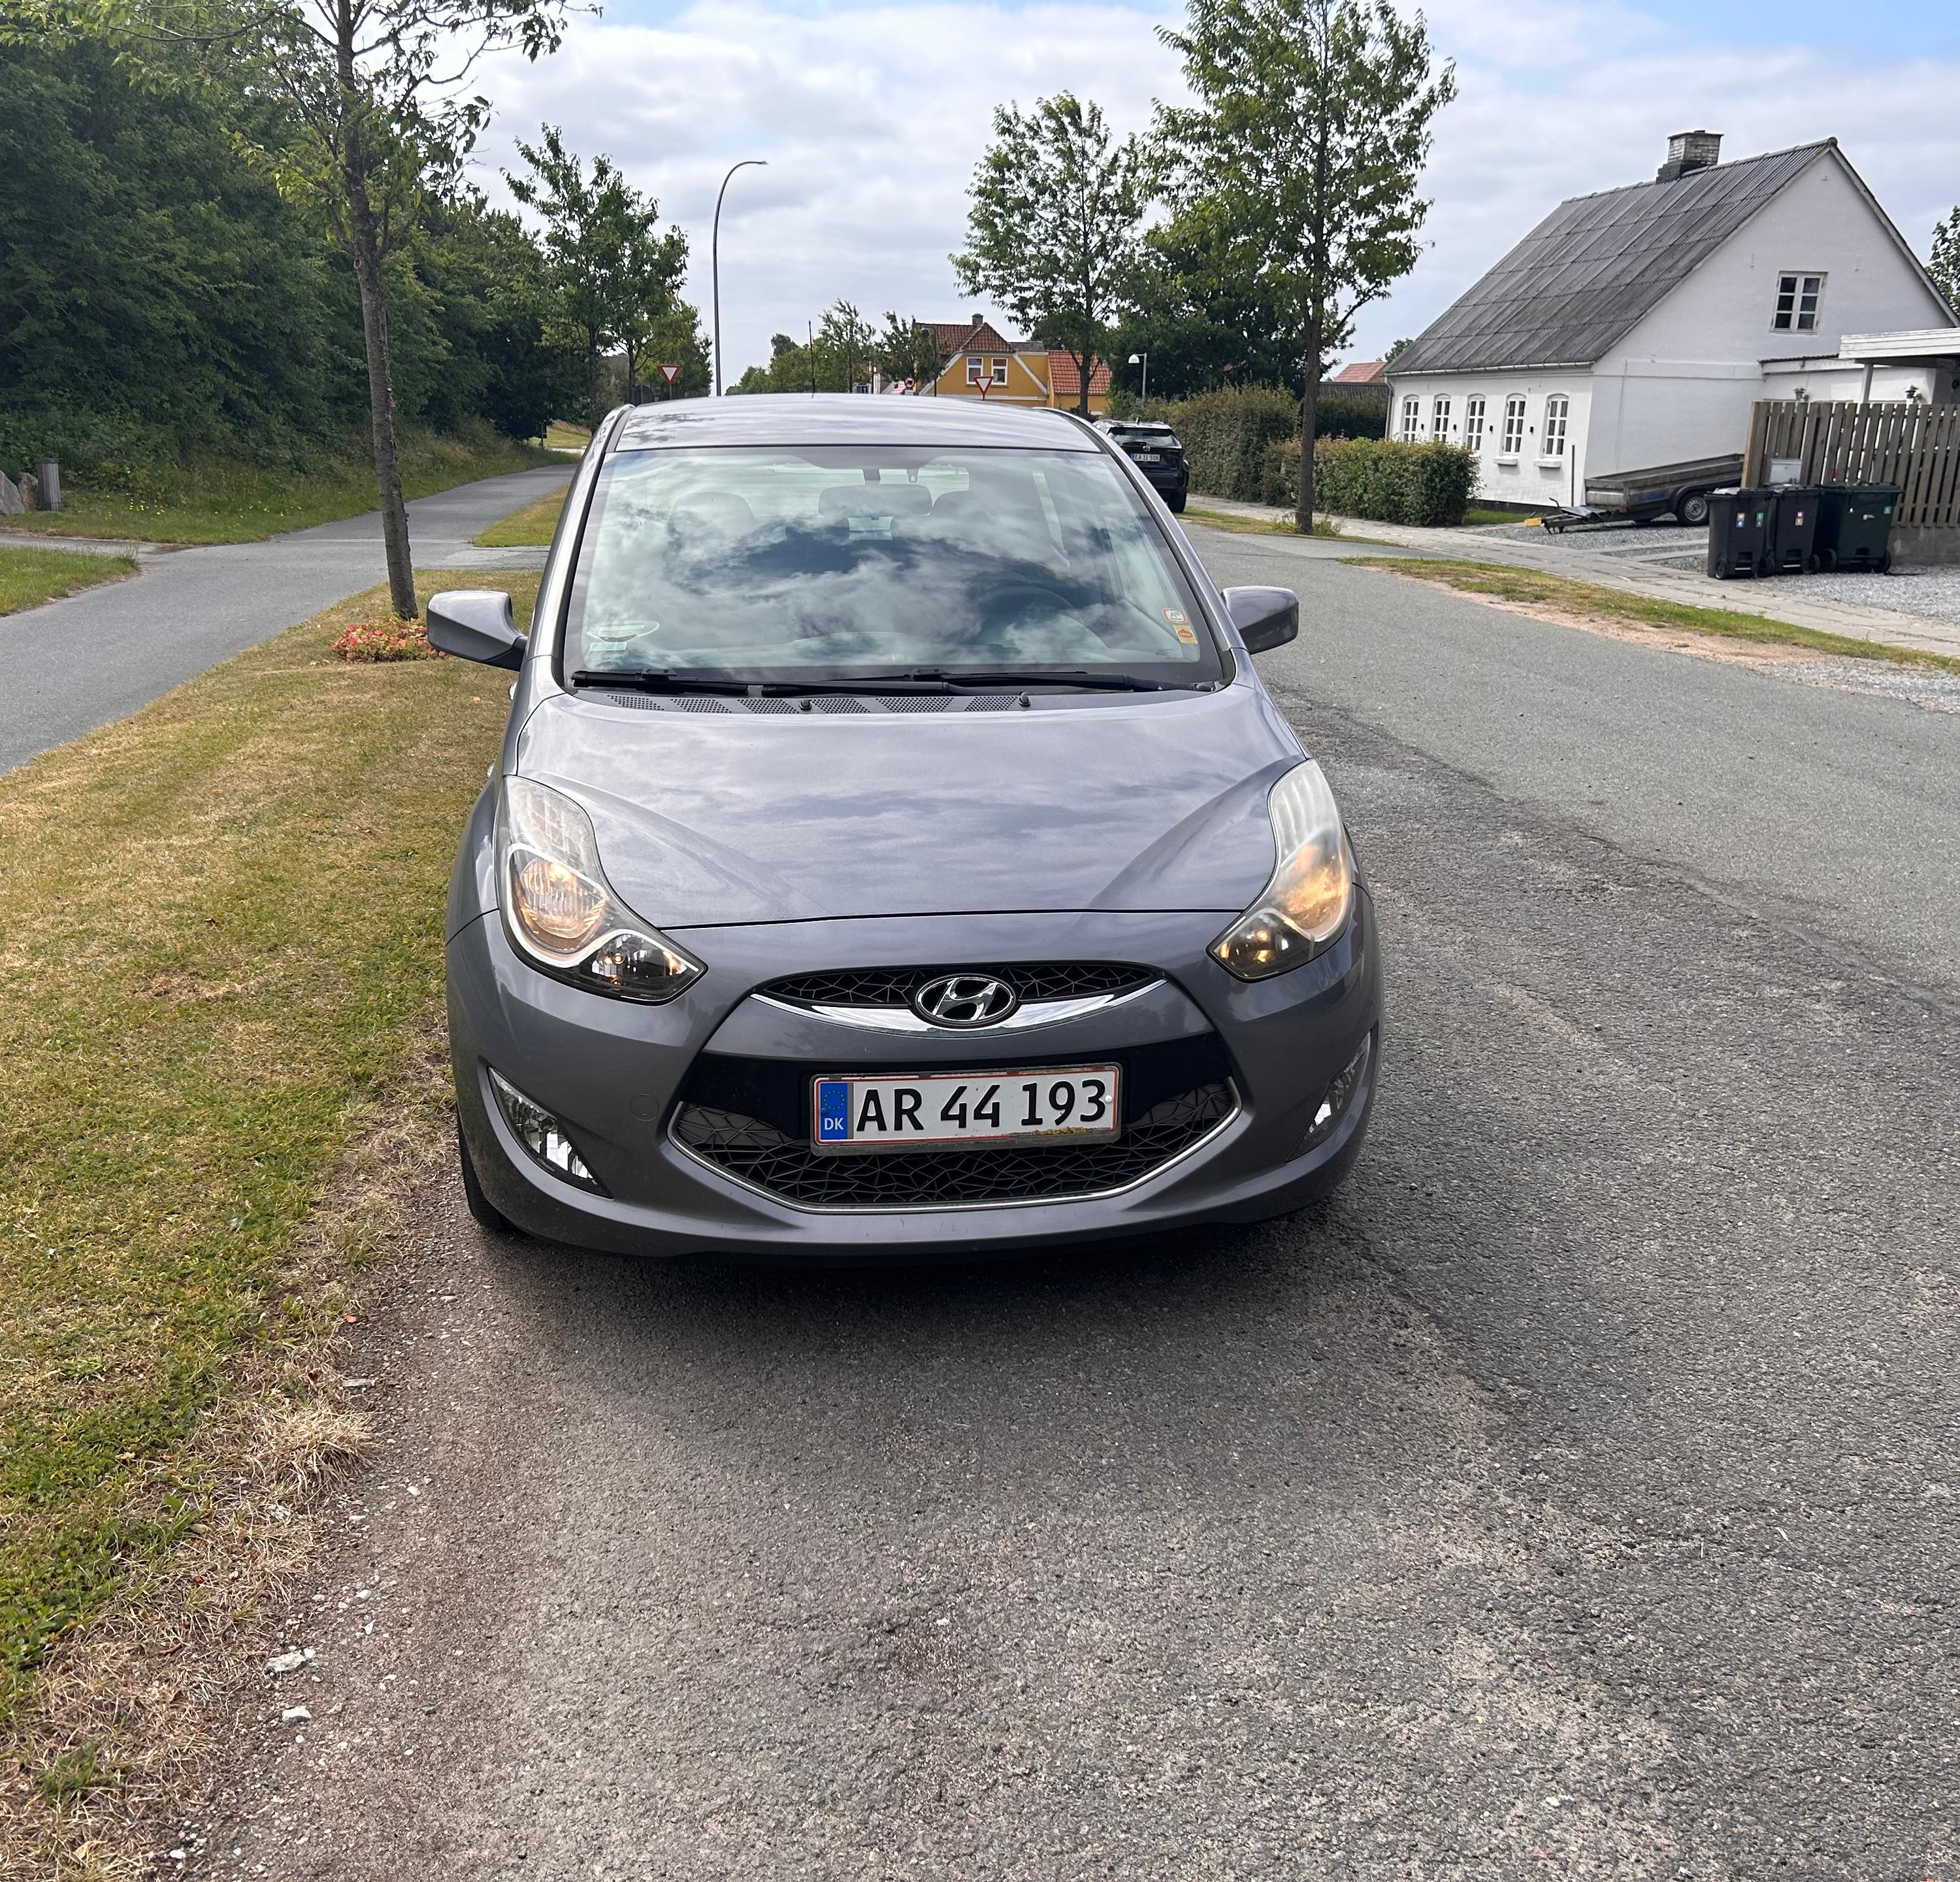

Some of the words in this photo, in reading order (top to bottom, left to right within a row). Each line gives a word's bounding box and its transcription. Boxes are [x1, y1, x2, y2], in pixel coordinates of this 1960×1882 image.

[856, 1088, 924, 1132] AR
[940, 1084, 1001, 1129] 44
[1021, 1078, 1106, 1126] 193
[824, 1117, 844, 1131] DK
